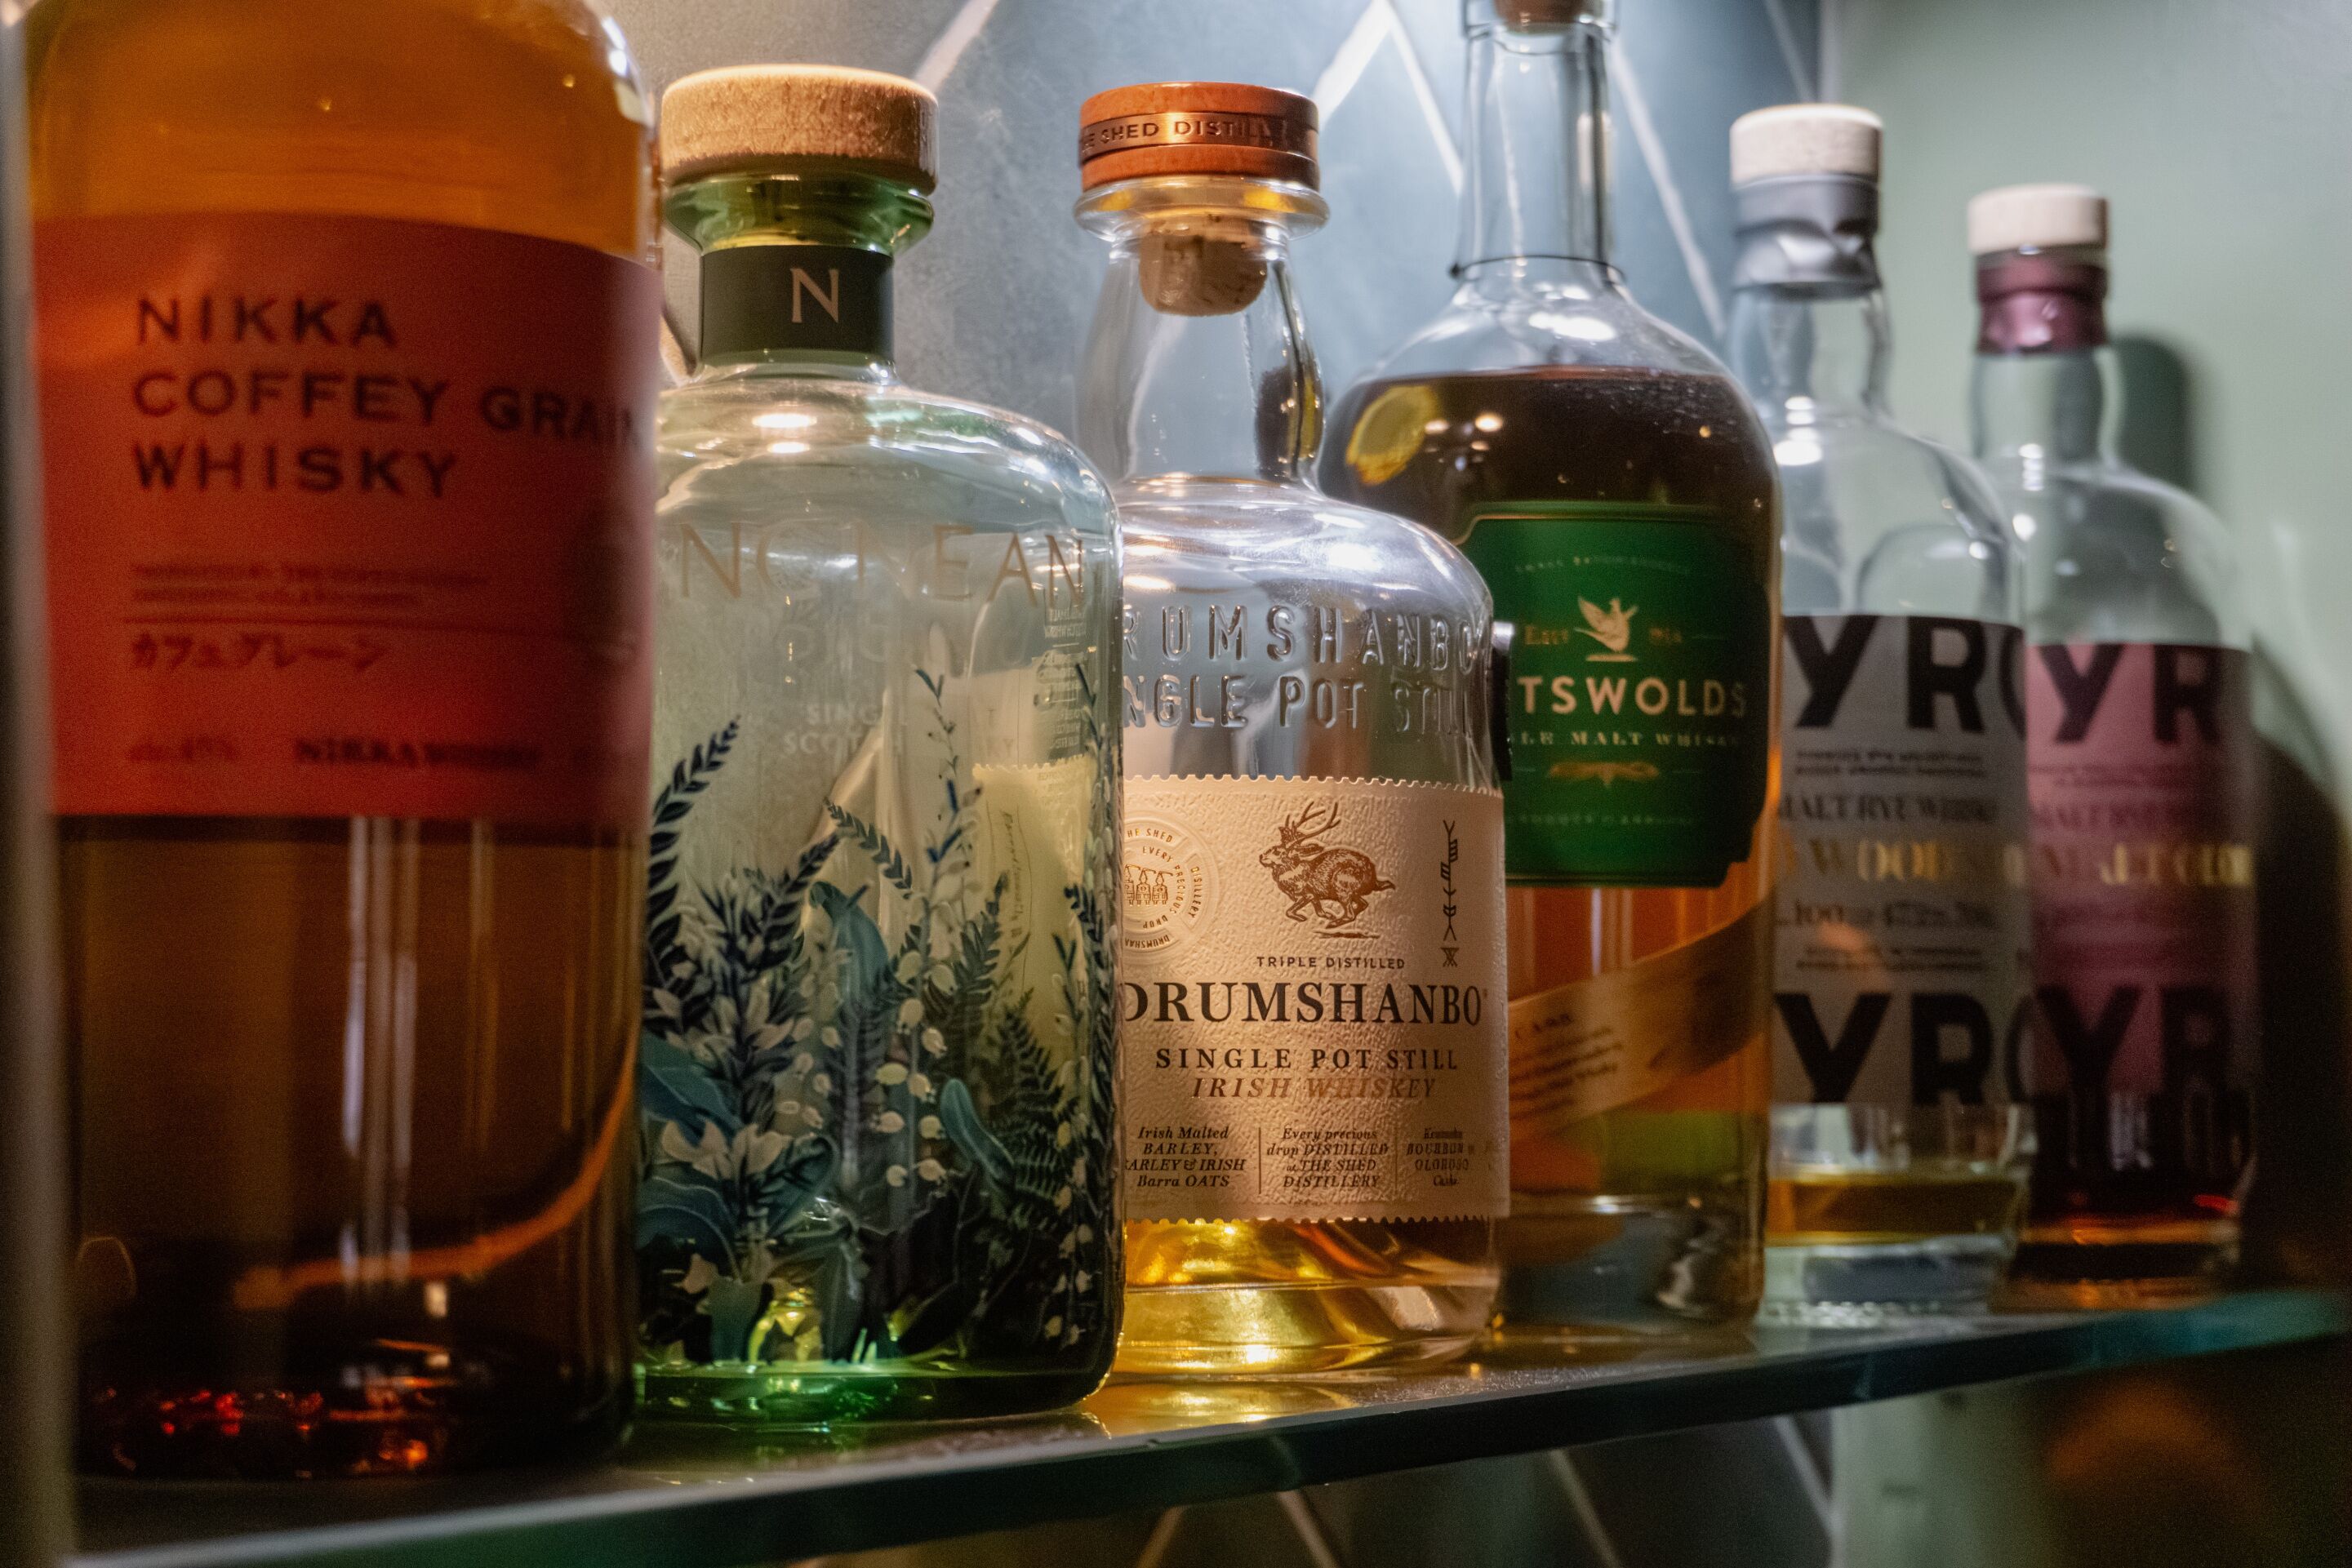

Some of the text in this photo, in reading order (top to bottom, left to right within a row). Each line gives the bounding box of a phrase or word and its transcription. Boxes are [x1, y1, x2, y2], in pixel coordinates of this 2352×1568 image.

[1100, 121, 1160, 144] SHED
[790, 267, 840, 324] N
[136, 297, 398, 348] NIKKA
[131, 370, 451, 424] COFFEY
[131, 442, 460, 497] WHISKY
[1278, 675, 1364, 729] POT
[1517, 675, 1748, 719] TSWOLDS
[1572, 731, 1643, 746] MALT
[1146, 828, 1173, 843] SHED
[1142, 846, 1186, 930] EVERY PRECIOUS DROP
[1256, 956, 1405, 970] TRIPLE DISTILLED
[1123, 982, 1482, 1026] DRUMSHANBO
[1156, 1048, 1458, 1071] SINGLE POT STILL
[1191, 1077, 1437, 1099] IRISH WHISKEY
[1137, 1125, 1229, 1139] Irish Malted
[1283, 1127, 1378, 1142] Every precious
[1144, 1143, 1218, 1157] BARLEY,
[1266, 1143, 1389, 1157] drop DISTILLED
[1124, 1158, 1182, 1171] ARLEY
[1200, 1158, 1247, 1171] IRISH
[1300, 1159, 1332, 1172] THE
[1336, 1159, 1377, 1172] SHED
[1137, 1174, 1231, 1187] Barra OATS
[1283, 1175, 1381, 1188] DISTILLERY
